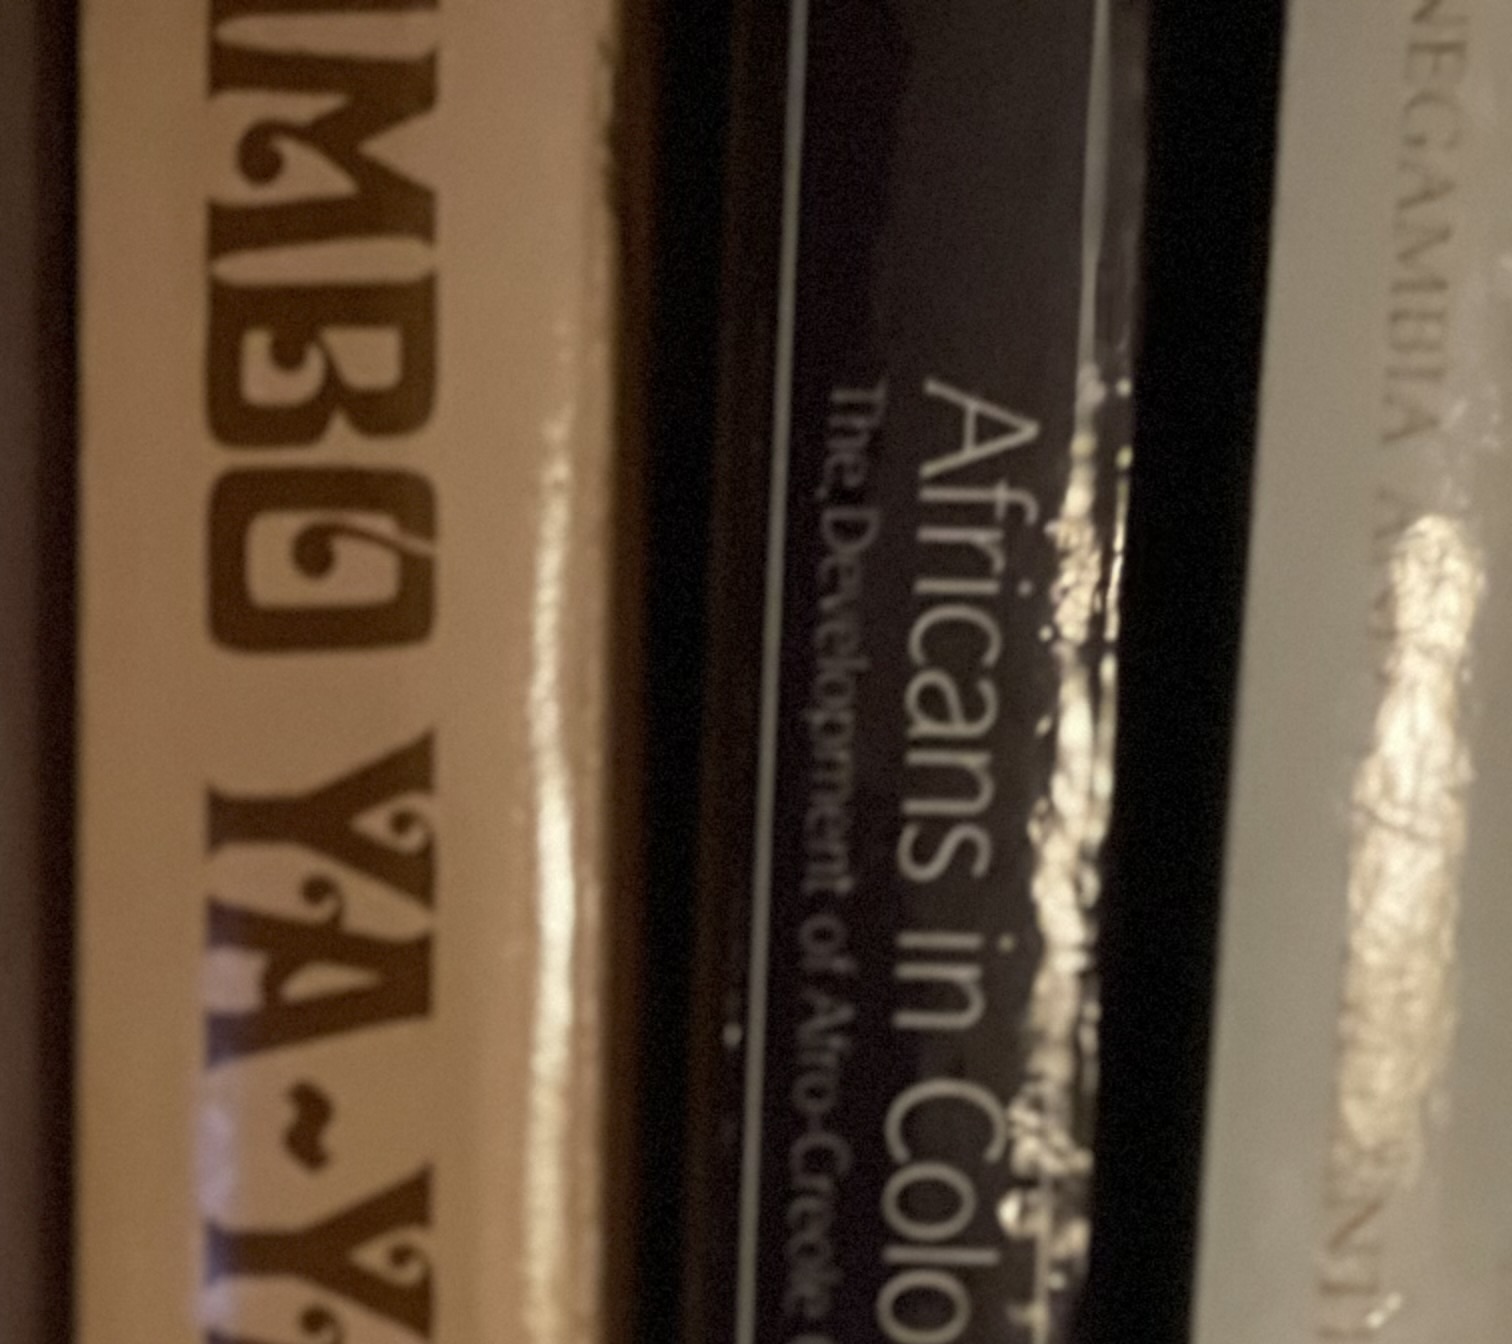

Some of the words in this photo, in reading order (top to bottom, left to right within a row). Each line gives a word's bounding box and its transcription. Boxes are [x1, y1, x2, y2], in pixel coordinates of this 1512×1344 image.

[823, 379, 886, 488] The
[896, 378, 1041, 883] Africans
[803, 503, 883, 893] Development
[799, 915, 860, 976] of
[892, 931, 1017, 1032] in
